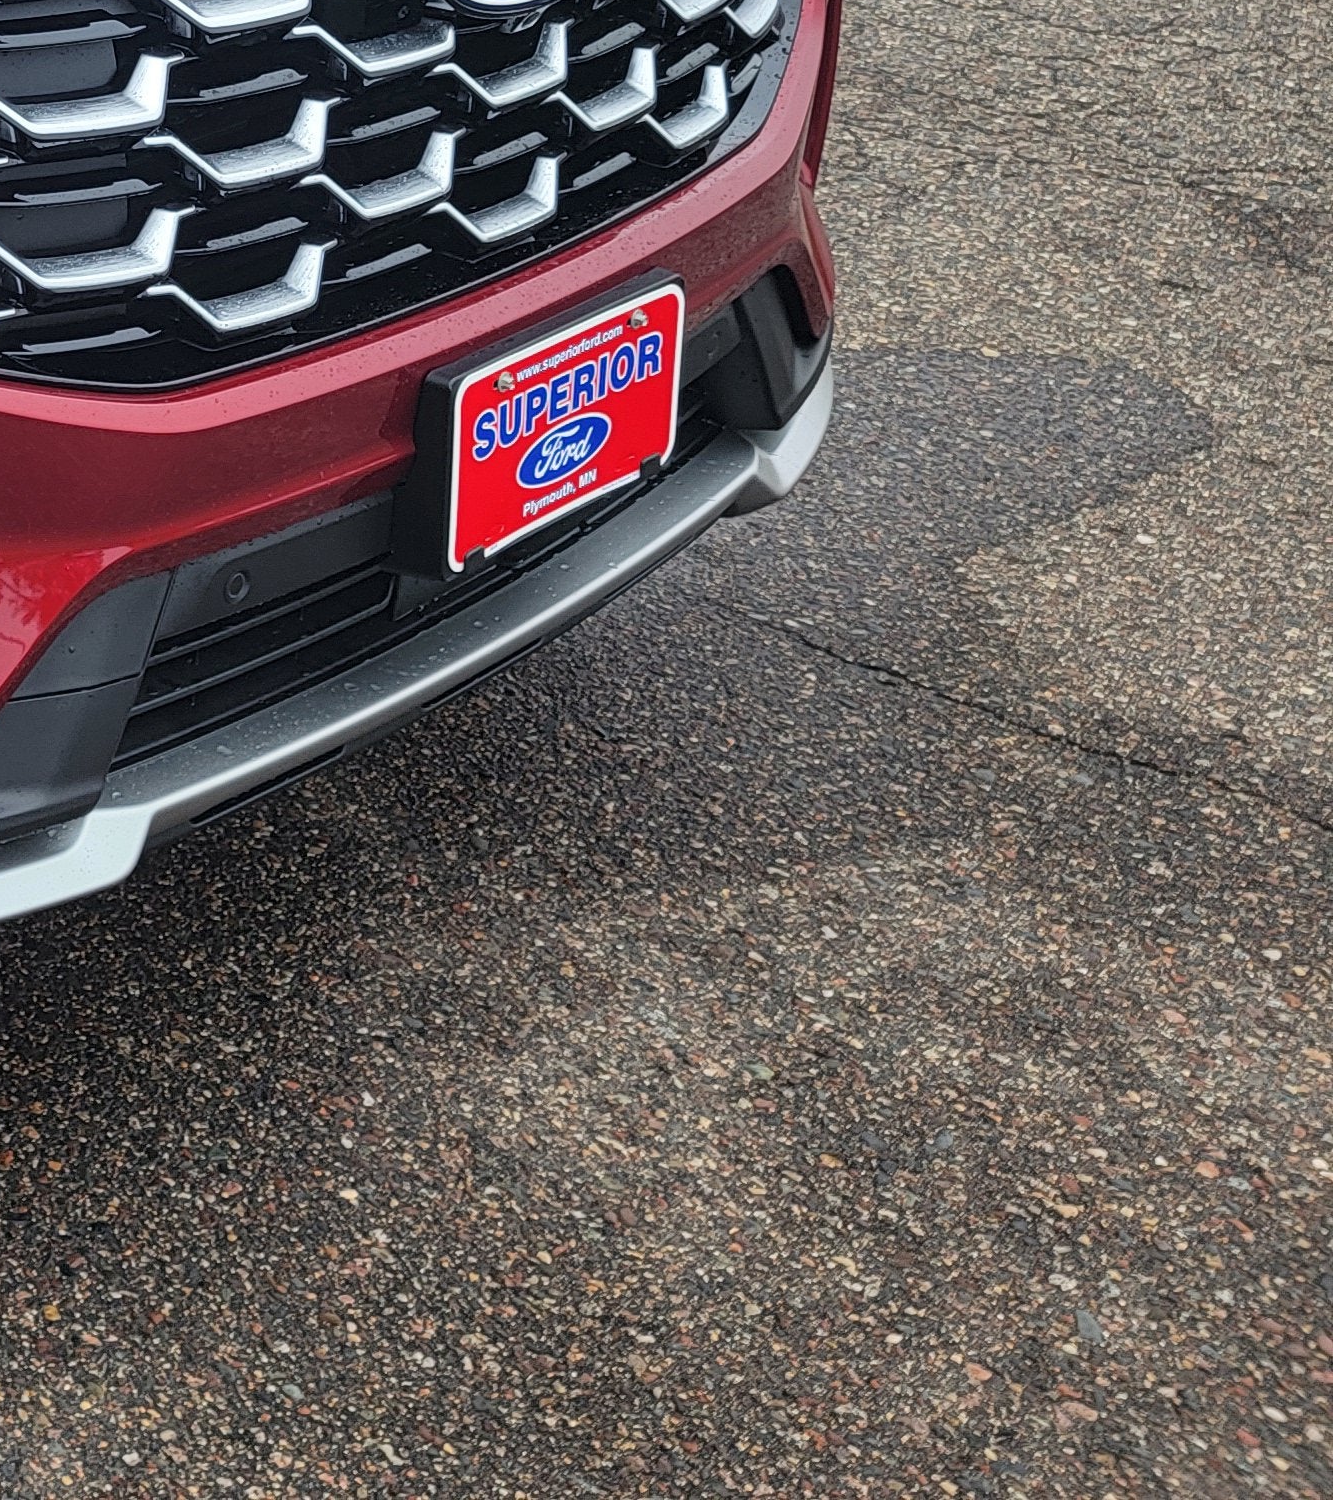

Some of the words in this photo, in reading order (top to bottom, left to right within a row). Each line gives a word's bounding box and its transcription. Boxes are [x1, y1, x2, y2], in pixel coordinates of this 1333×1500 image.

[516, 323, 624, 382] www.superiorford.com
[472, 331, 663, 461] SUPERIOR
[534, 426, 592, 479] Ford
[522, 481, 577, 517] Plymouth,
[578, 468, 598, 489] MN
